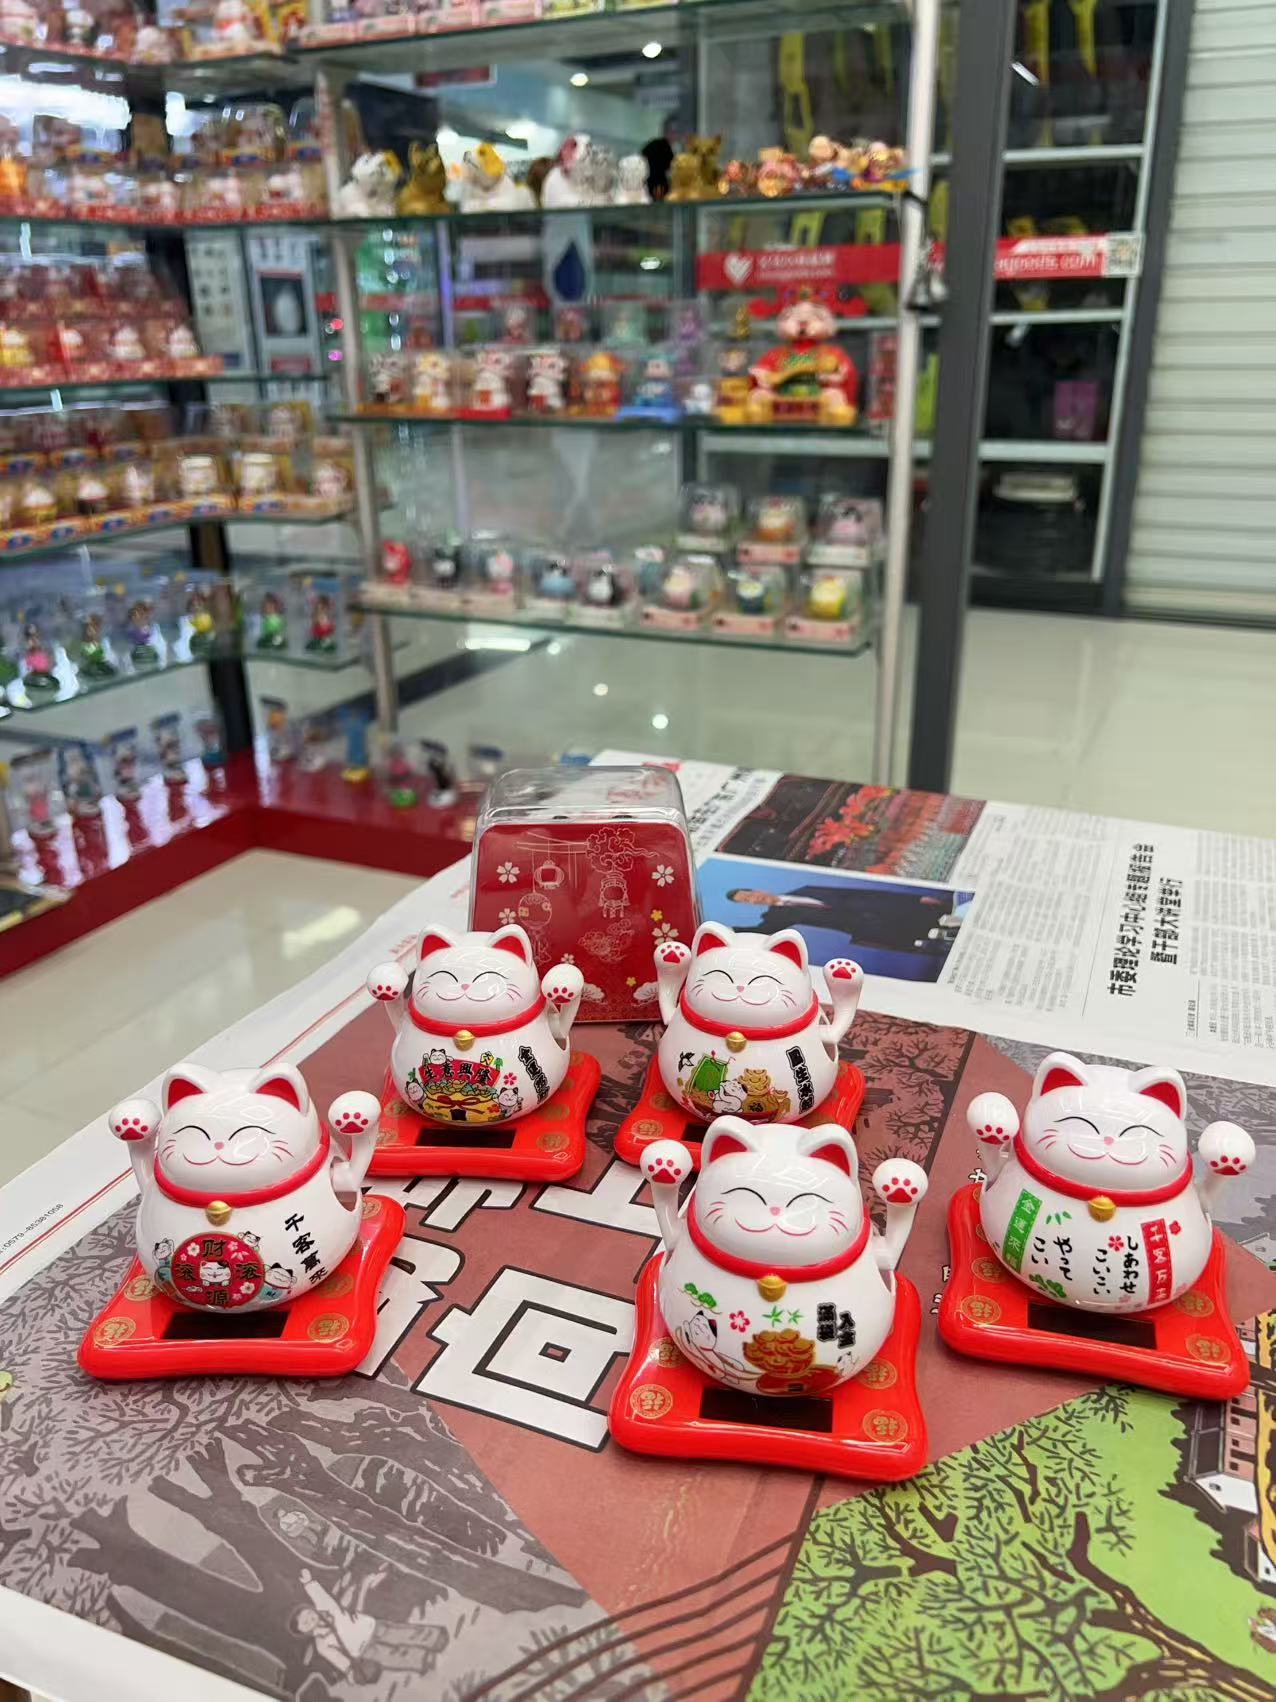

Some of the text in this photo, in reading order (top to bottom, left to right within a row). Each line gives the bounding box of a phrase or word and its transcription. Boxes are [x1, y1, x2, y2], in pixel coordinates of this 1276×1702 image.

[424, 1062, 494, 1086] 生意興隆
[1031, 1236, 1049, 1265] こい
[1053, 1236, 1073, 1281] やって
[1092, 1248, 1111, 1295] こいこい
[1120, 1235, 1139, 1294] しあわせ
